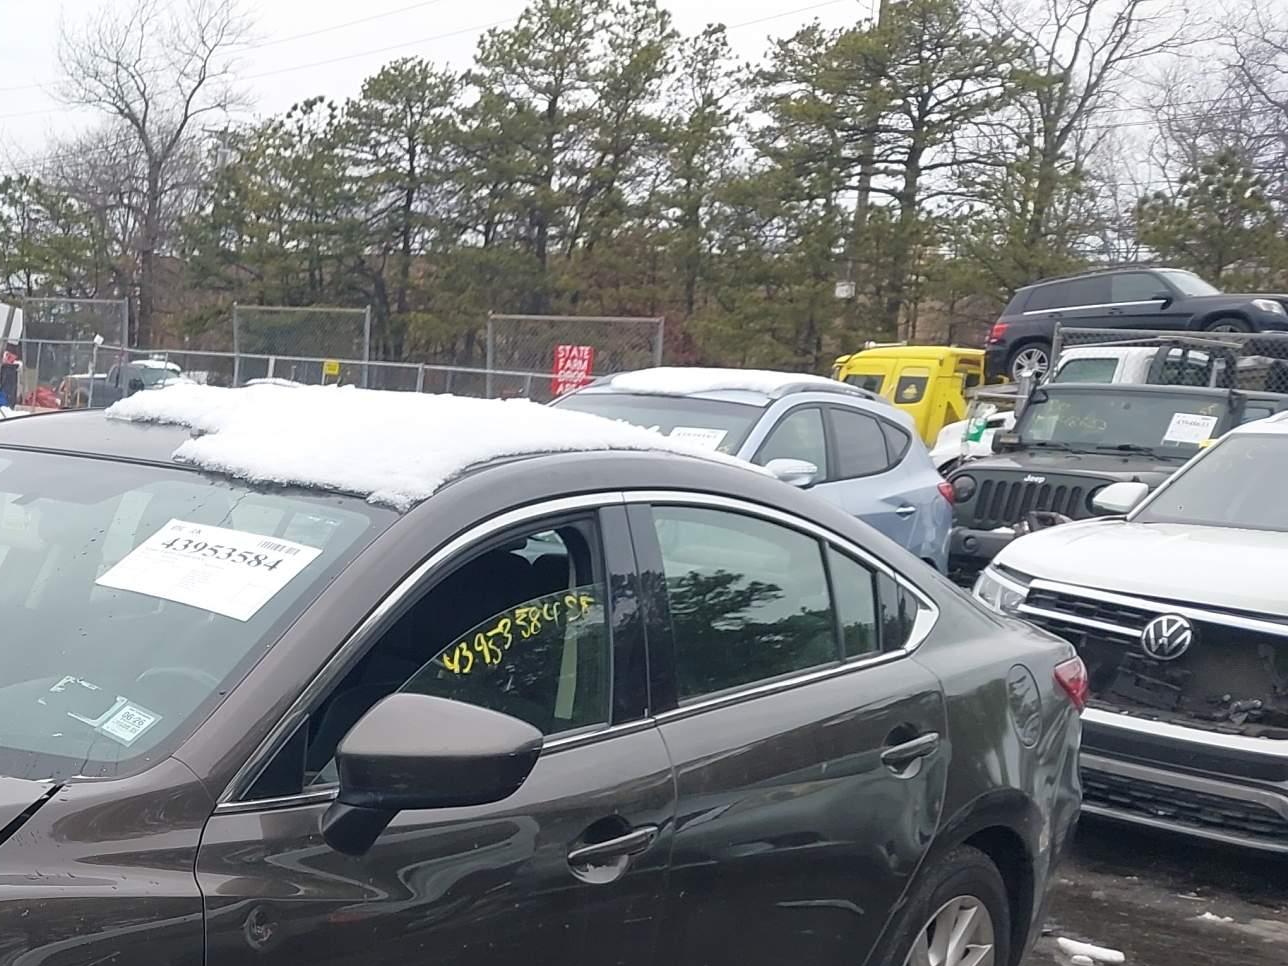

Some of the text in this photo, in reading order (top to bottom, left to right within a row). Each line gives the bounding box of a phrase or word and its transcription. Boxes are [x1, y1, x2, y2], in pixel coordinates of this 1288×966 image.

[558, 345, 591, 358] STATE
[558, 358, 588, 370] FARM
[1023, 474, 1046, 484] Jeep
[161, 537, 283, 572] 43953584
[442, 602, 560, 674] 43953584
